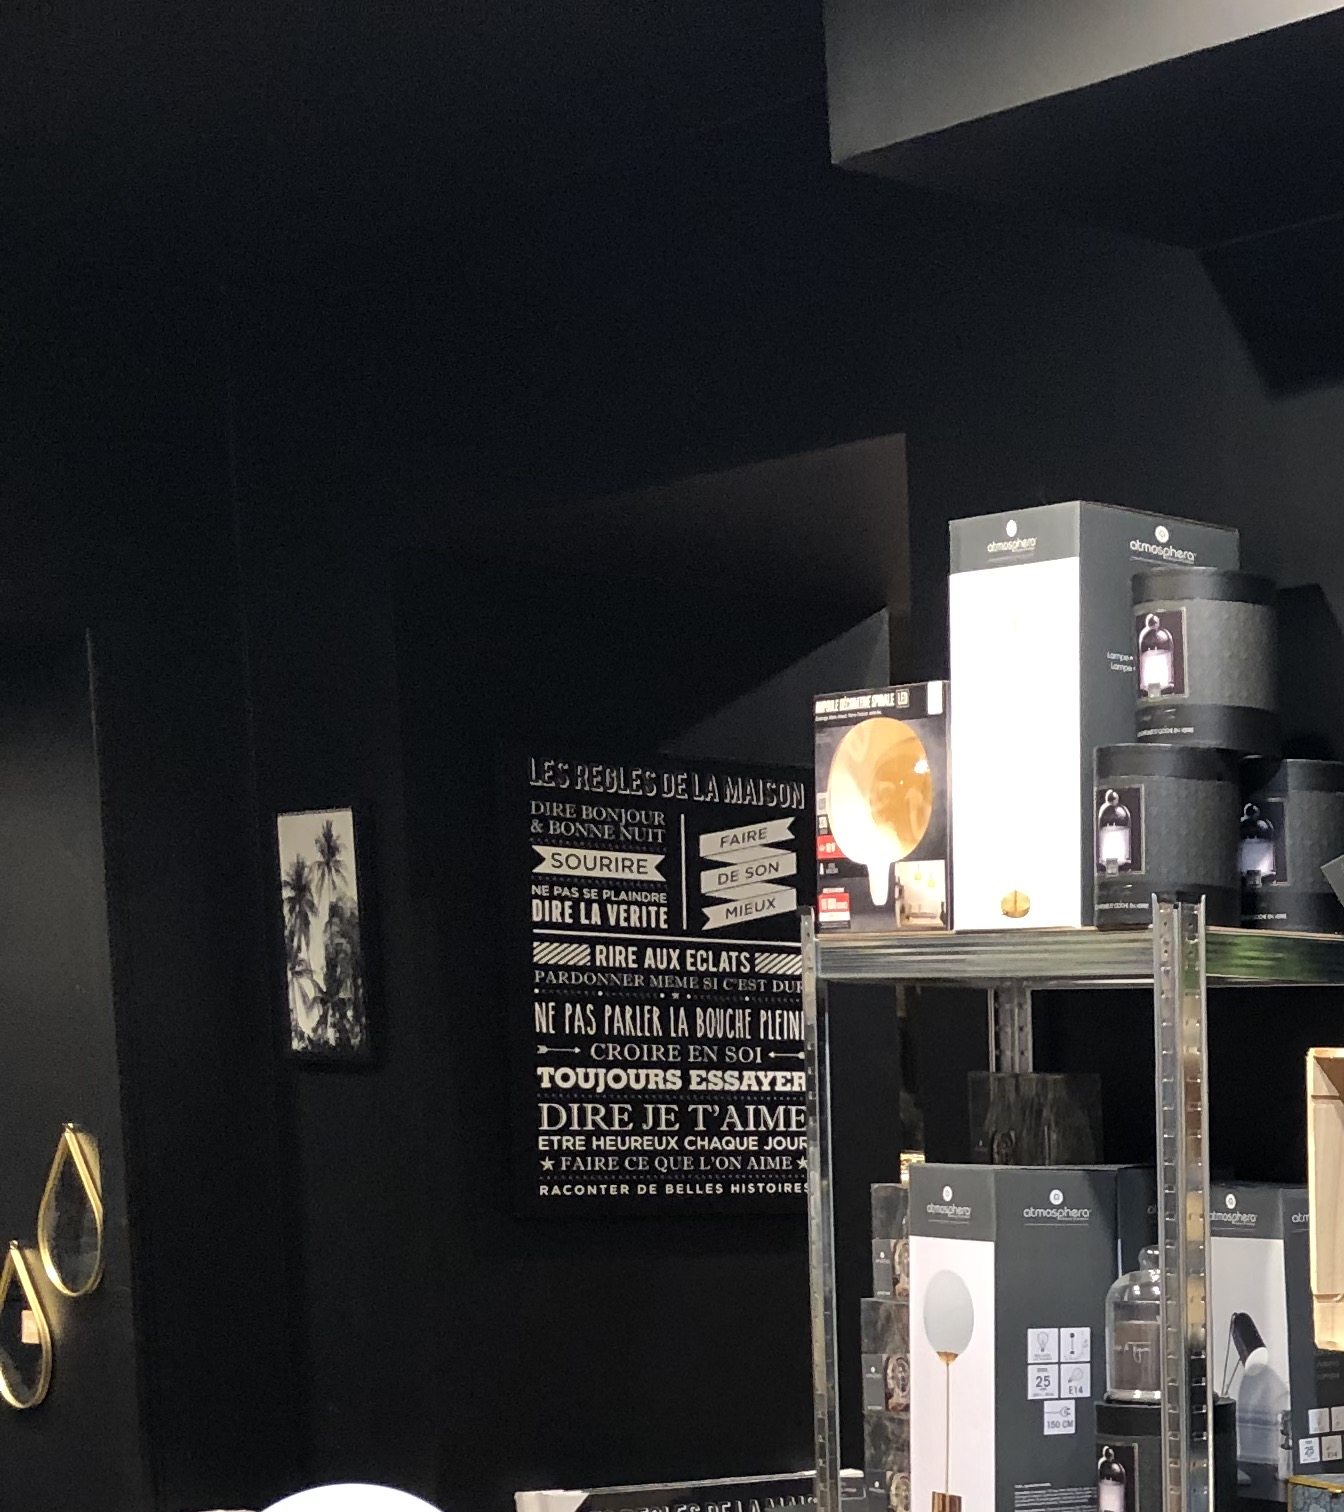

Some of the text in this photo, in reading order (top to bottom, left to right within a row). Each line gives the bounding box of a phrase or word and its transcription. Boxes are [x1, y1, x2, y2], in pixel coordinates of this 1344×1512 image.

[1130, 540, 1196, 562] atmosphera
[529, 757, 806, 810] LES REGLES DE LA MAISON
[530, 800, 666, 826] DIRE BONJOUR
[530, 818, 666, 843] & BONNE NUIT
[720, 827, 768, 848] FAIRE
[550, 852, 648, 874] SOURIRE
[717, 861, 780, 886] DE SON
[531, 884, 668, 904] NE PAS SE PLAINDRE
[531, 898, 668, 929] DIRE LA VERITE
[725, 897, 776, 920] MIEUX
[595, 944, 751, 973] RIRE AUX ECLATS
[534, 970, 645, 987] PARDONNER
[650, 974, 700, 990] MEME
[702, 977, 718, 990] SI
[722, 978, 768, 992] C'EST
[534, 1002, 556, 1034] NE
[564, 1002, 596, 1035] PAS
[604, 1004, 663, 1037] PARLER
[670, 1006, 689, 1038] LA
[696, 1006, 752, 1040] BOUCHE
[590, 1042, 762, 1064] CROIRE EN SOI
[536, 1066, 806, 1093] TOUJOURS ESSAYER
[537, 1103, 634, 1131] DIRE
[641, 1104, 680, 1131] JE
[538, 1136, 586, 1150] ETRE
[592, 1136, 680, 1150] HEUREUX
[684, 1136, 759, 1150] CHAQUE
[560, 1156, 793, 1172] FAIRE CE QUE L'ON AIME
[540, 1184, 630, 1196] RACONTER
[637, 1184, 658, 1195] DE
[665, 1183, 723, 1194] BELLES
[926, 1202, 972, 1218] atmosphera
[1023, 1206, 1090, 1220] atmosphera
[1035, 1375, 1051, 1388] 25
[1068, 1386, 1084, 1396] E14
[1046, 1420, 1060, 1430] 150
